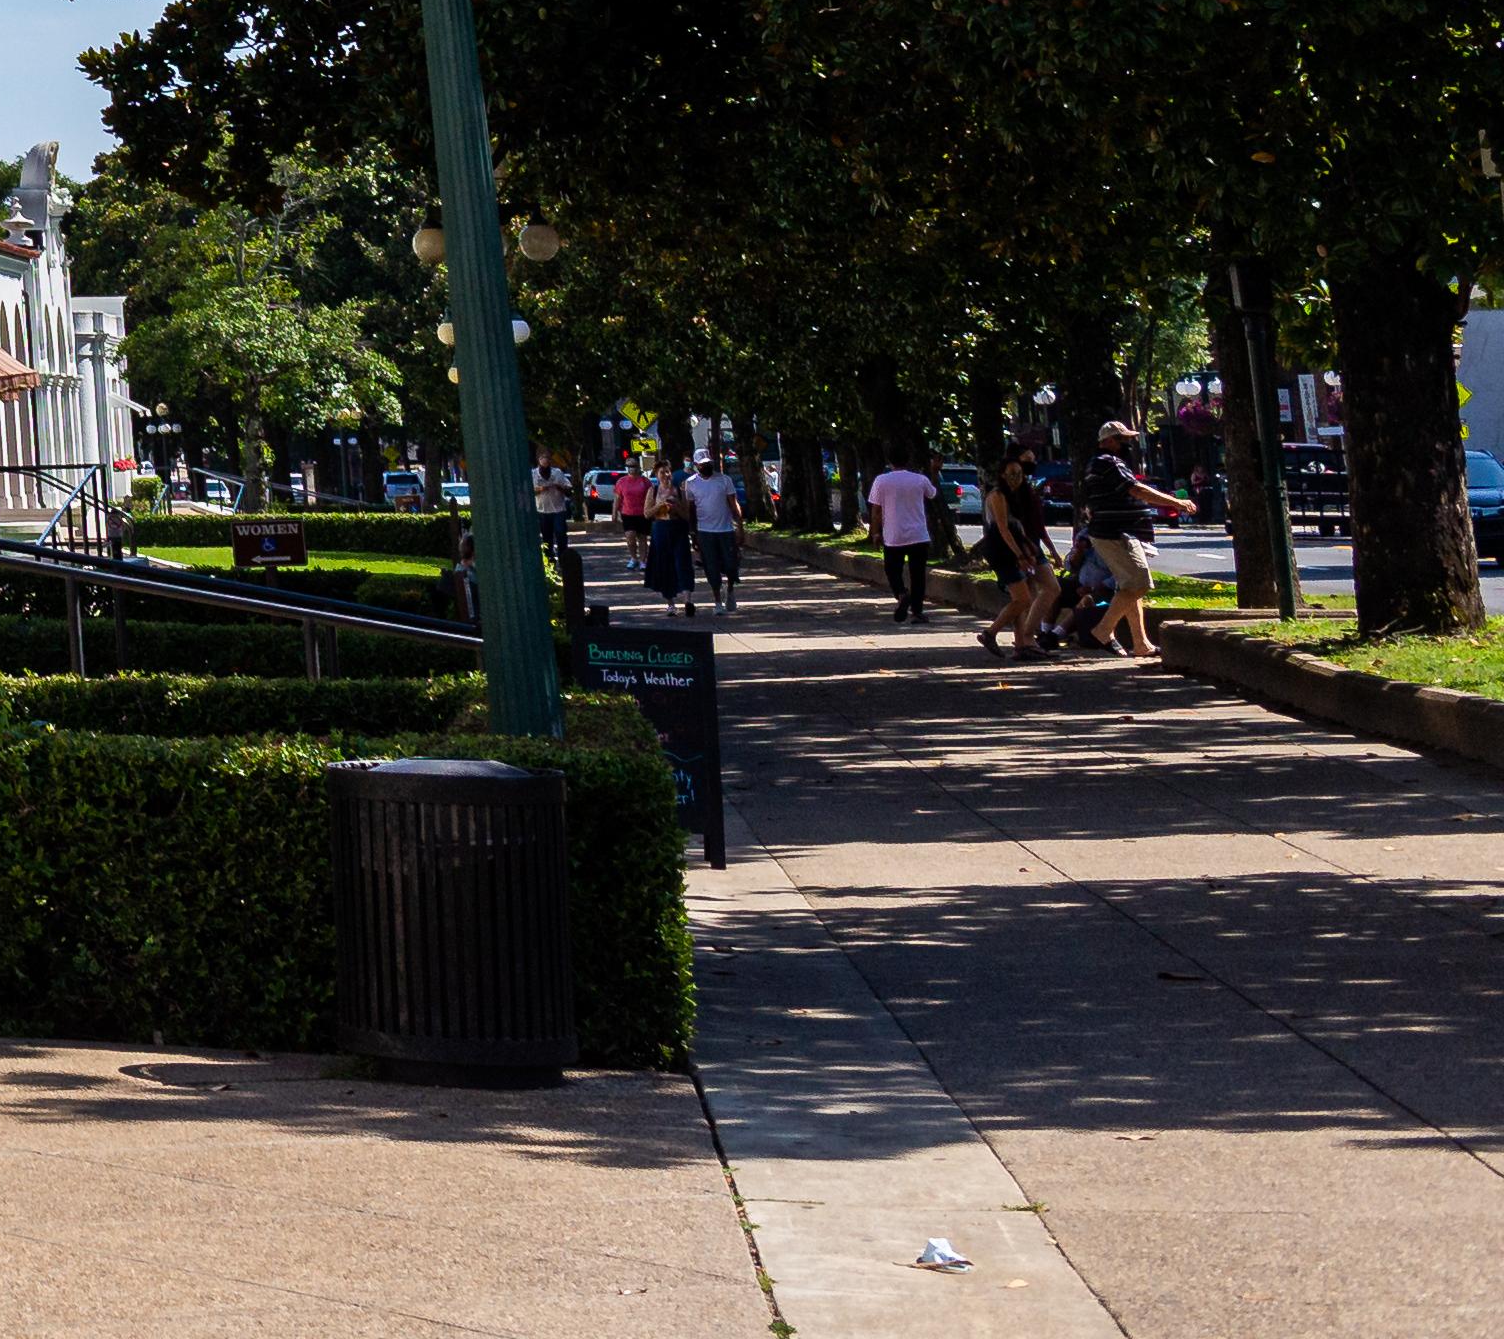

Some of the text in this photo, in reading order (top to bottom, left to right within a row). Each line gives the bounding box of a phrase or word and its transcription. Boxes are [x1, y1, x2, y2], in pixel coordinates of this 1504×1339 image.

[234, 523, 299, 536] WOMEN
[648, 644, 694, 664] CLOSED
[600, 668, 695, 690] Today's Weather
